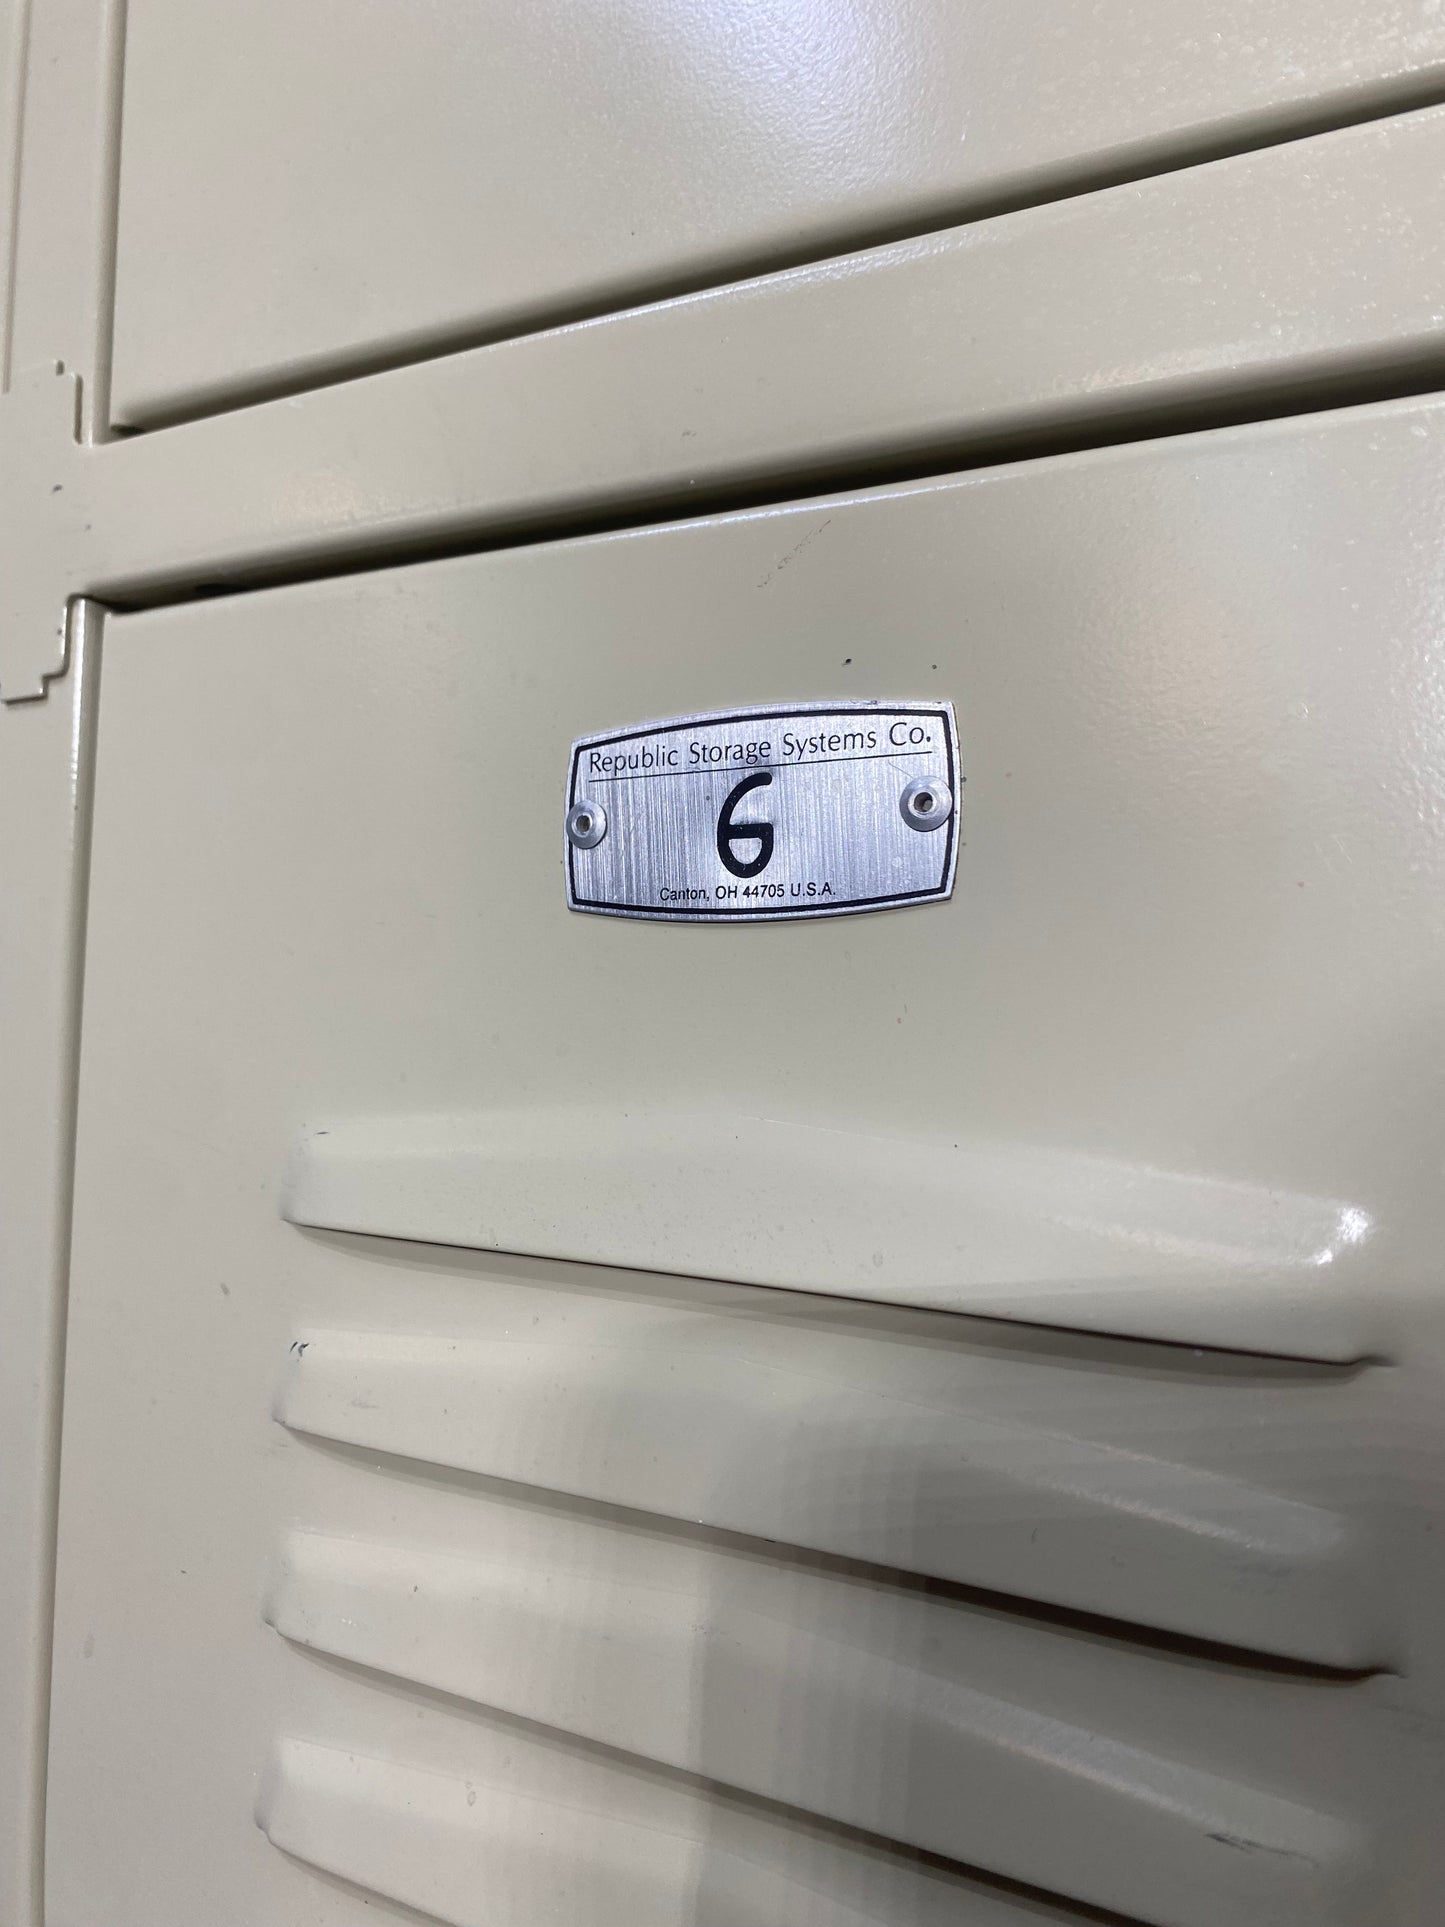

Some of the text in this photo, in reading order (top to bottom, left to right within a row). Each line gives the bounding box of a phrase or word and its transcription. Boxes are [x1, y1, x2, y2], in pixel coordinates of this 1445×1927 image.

[590, 722, 931, 776] Republic Storage Systems Co.
[717, 772, 774, 879] 6
[660, 882, 836, 901] Canton, OH 44705 U.S.A.
